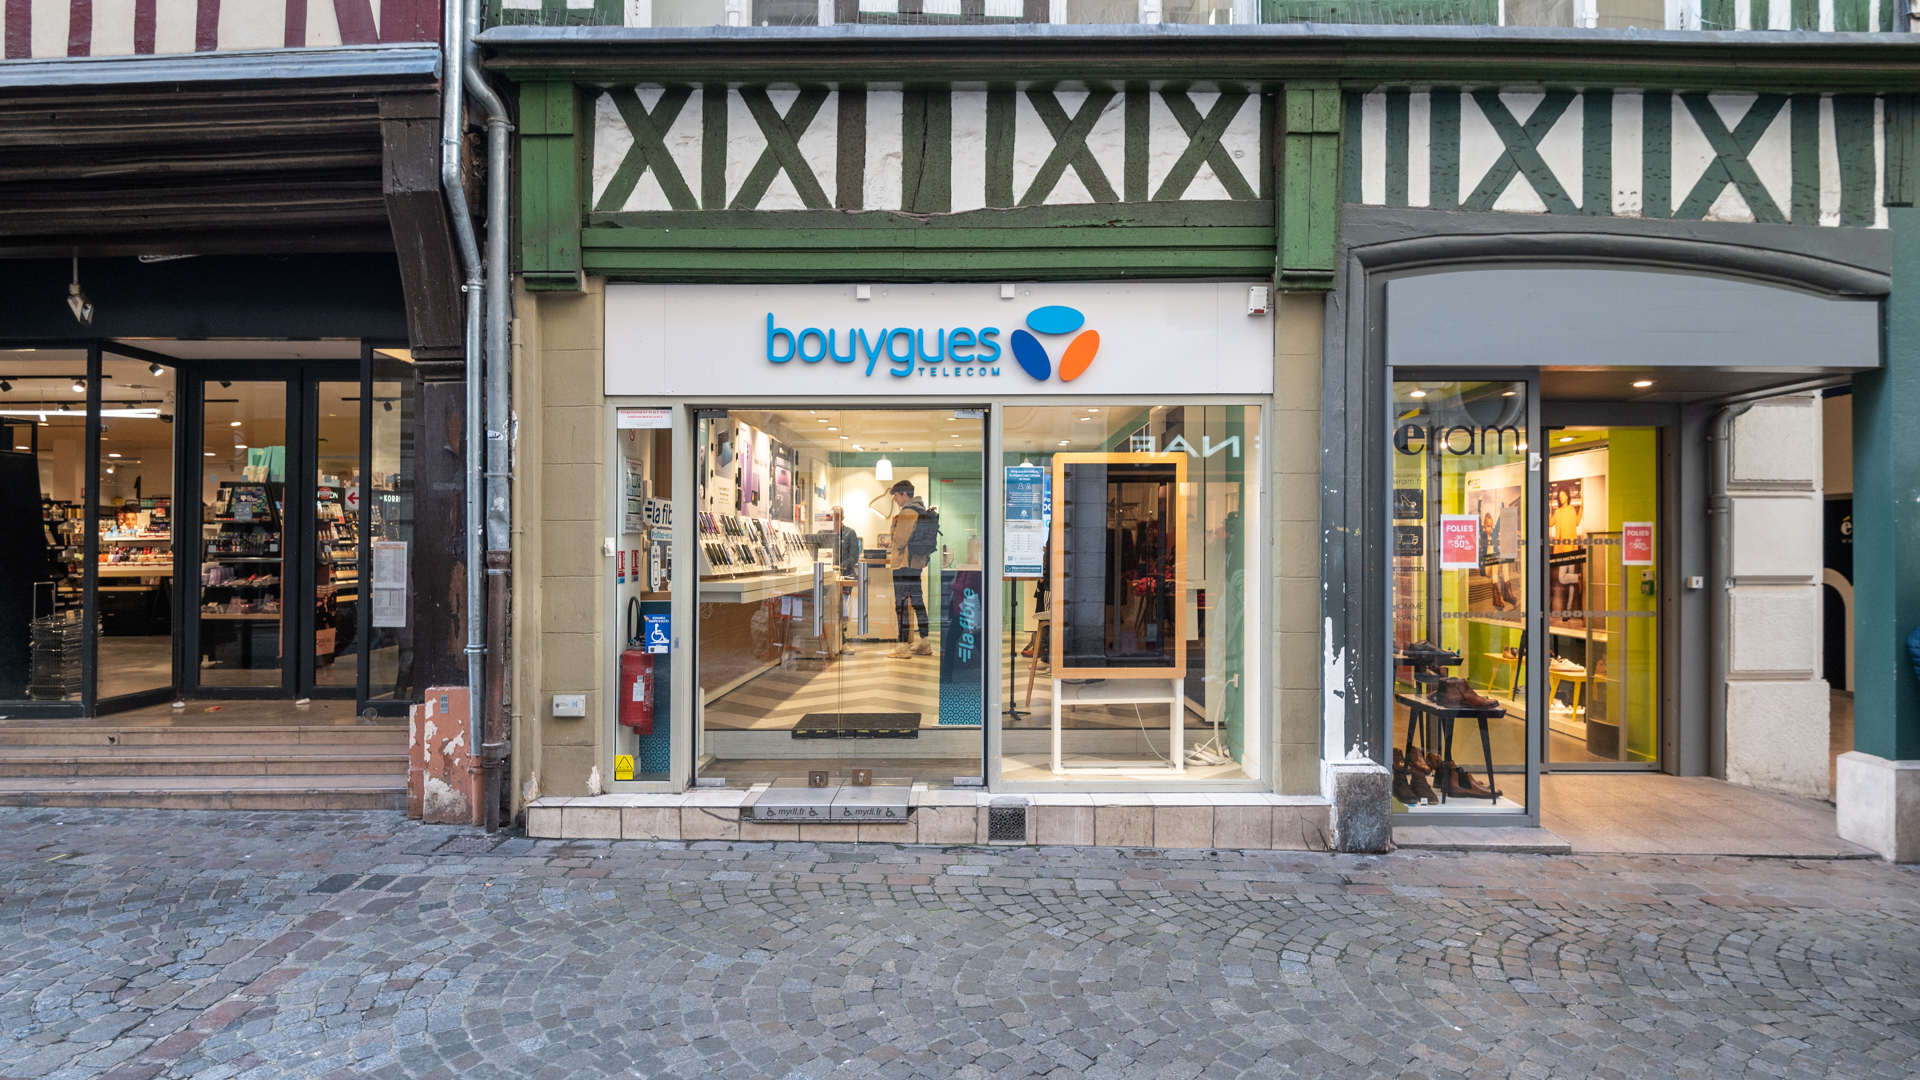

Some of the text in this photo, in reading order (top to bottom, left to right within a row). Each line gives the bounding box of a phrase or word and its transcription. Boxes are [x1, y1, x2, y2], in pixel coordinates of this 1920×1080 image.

[767, 312, 1001, 377] bouygues
[918, 367, 1001, 377] TELECOM
[1393, 407, 1520, 456] éram
[652, 502, 660, 524] la
[1451, 540, 1470, 548] -50%
[959, 588, 976, 649] la fibre
